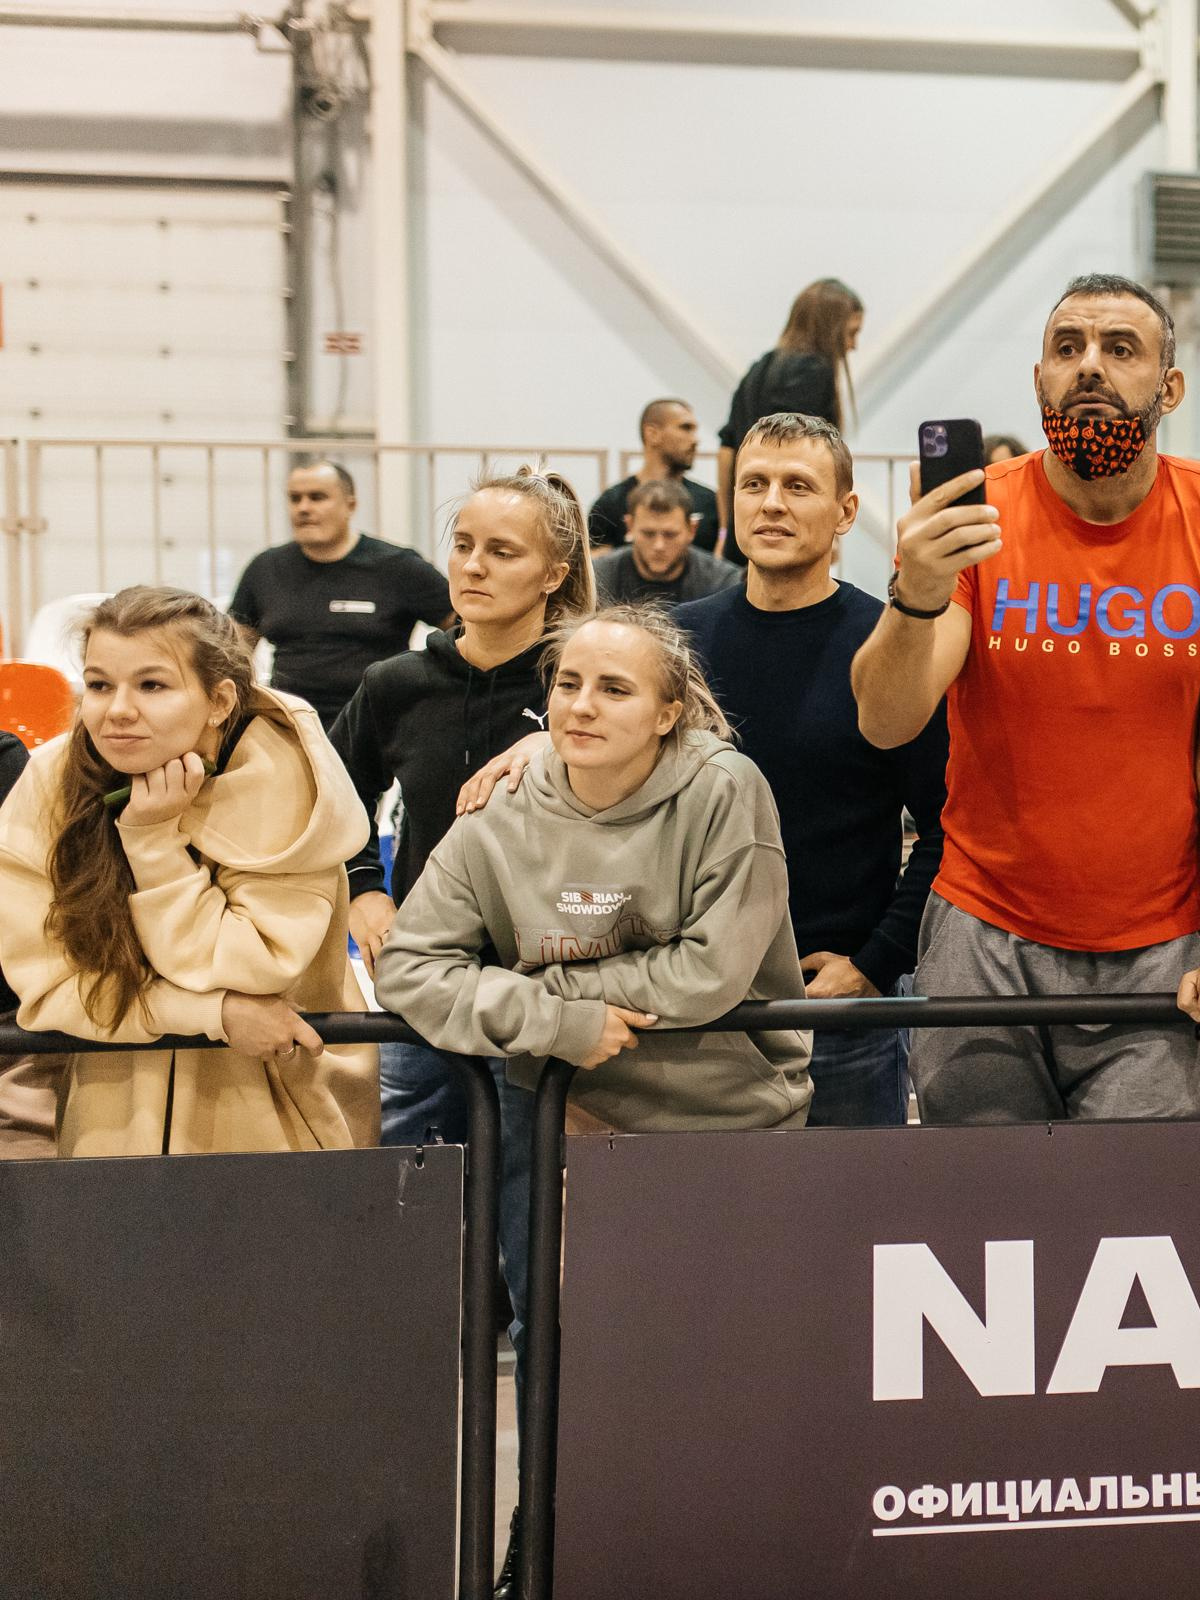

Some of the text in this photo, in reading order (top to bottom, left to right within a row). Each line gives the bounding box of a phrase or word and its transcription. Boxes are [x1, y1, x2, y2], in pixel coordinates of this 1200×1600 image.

[988, 636, 1198, 657] HUGO BOSS
[560, 890, 625, 904] SIBRIAN
